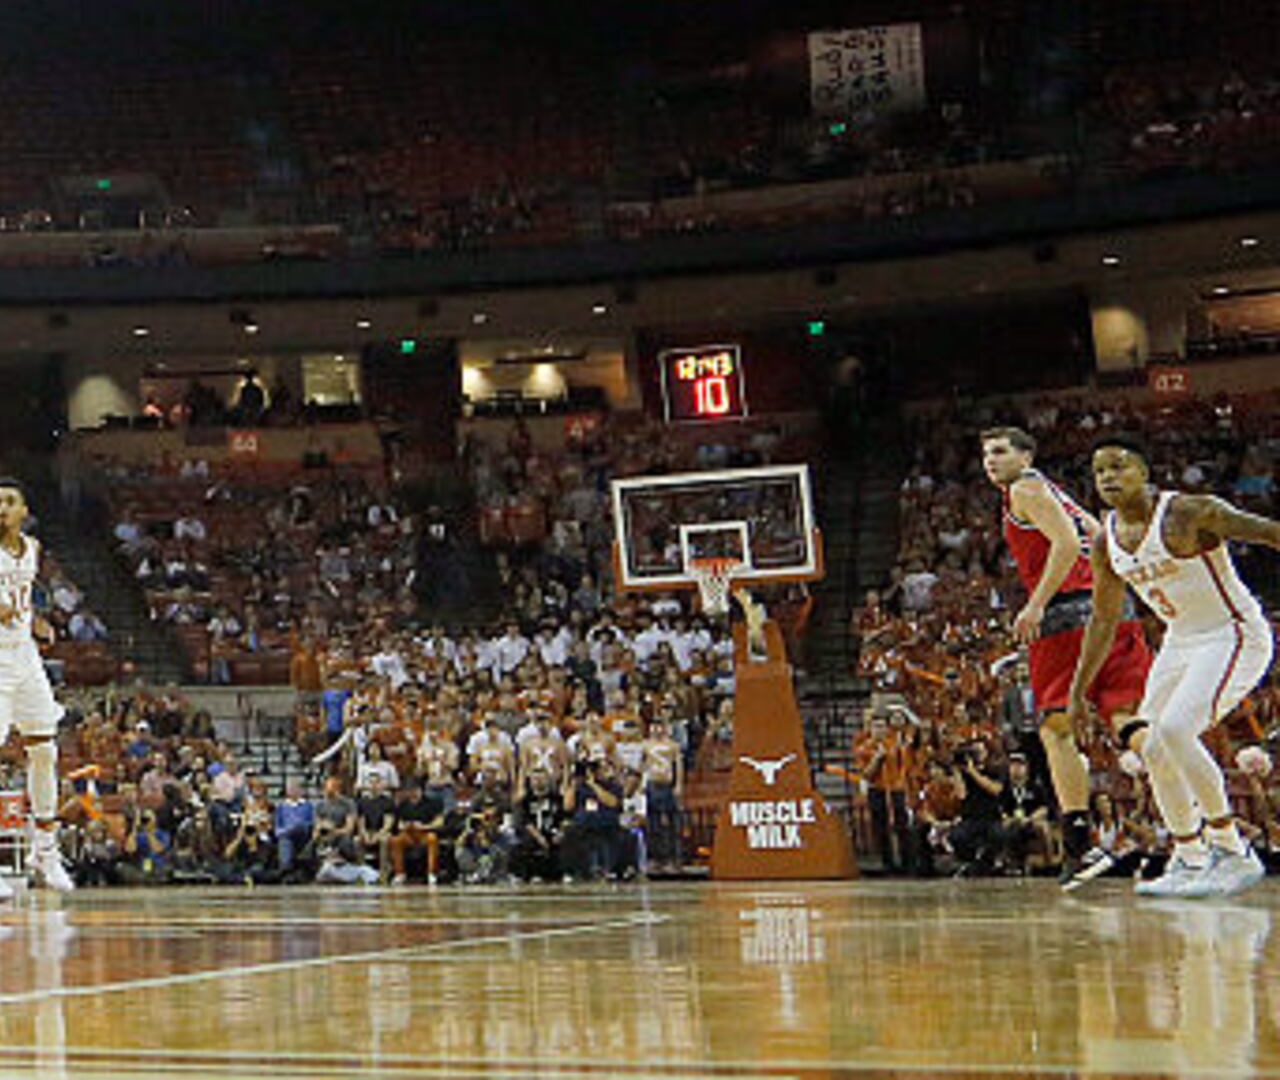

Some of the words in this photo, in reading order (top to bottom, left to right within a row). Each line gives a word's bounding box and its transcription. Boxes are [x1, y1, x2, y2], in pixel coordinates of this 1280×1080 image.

[694, 378, 730, 413] 10
[1148, 586, 1177, 619] 3
[729, 797, 817, 827] MUSCLE
[747, 823, 803, 850] MILK
